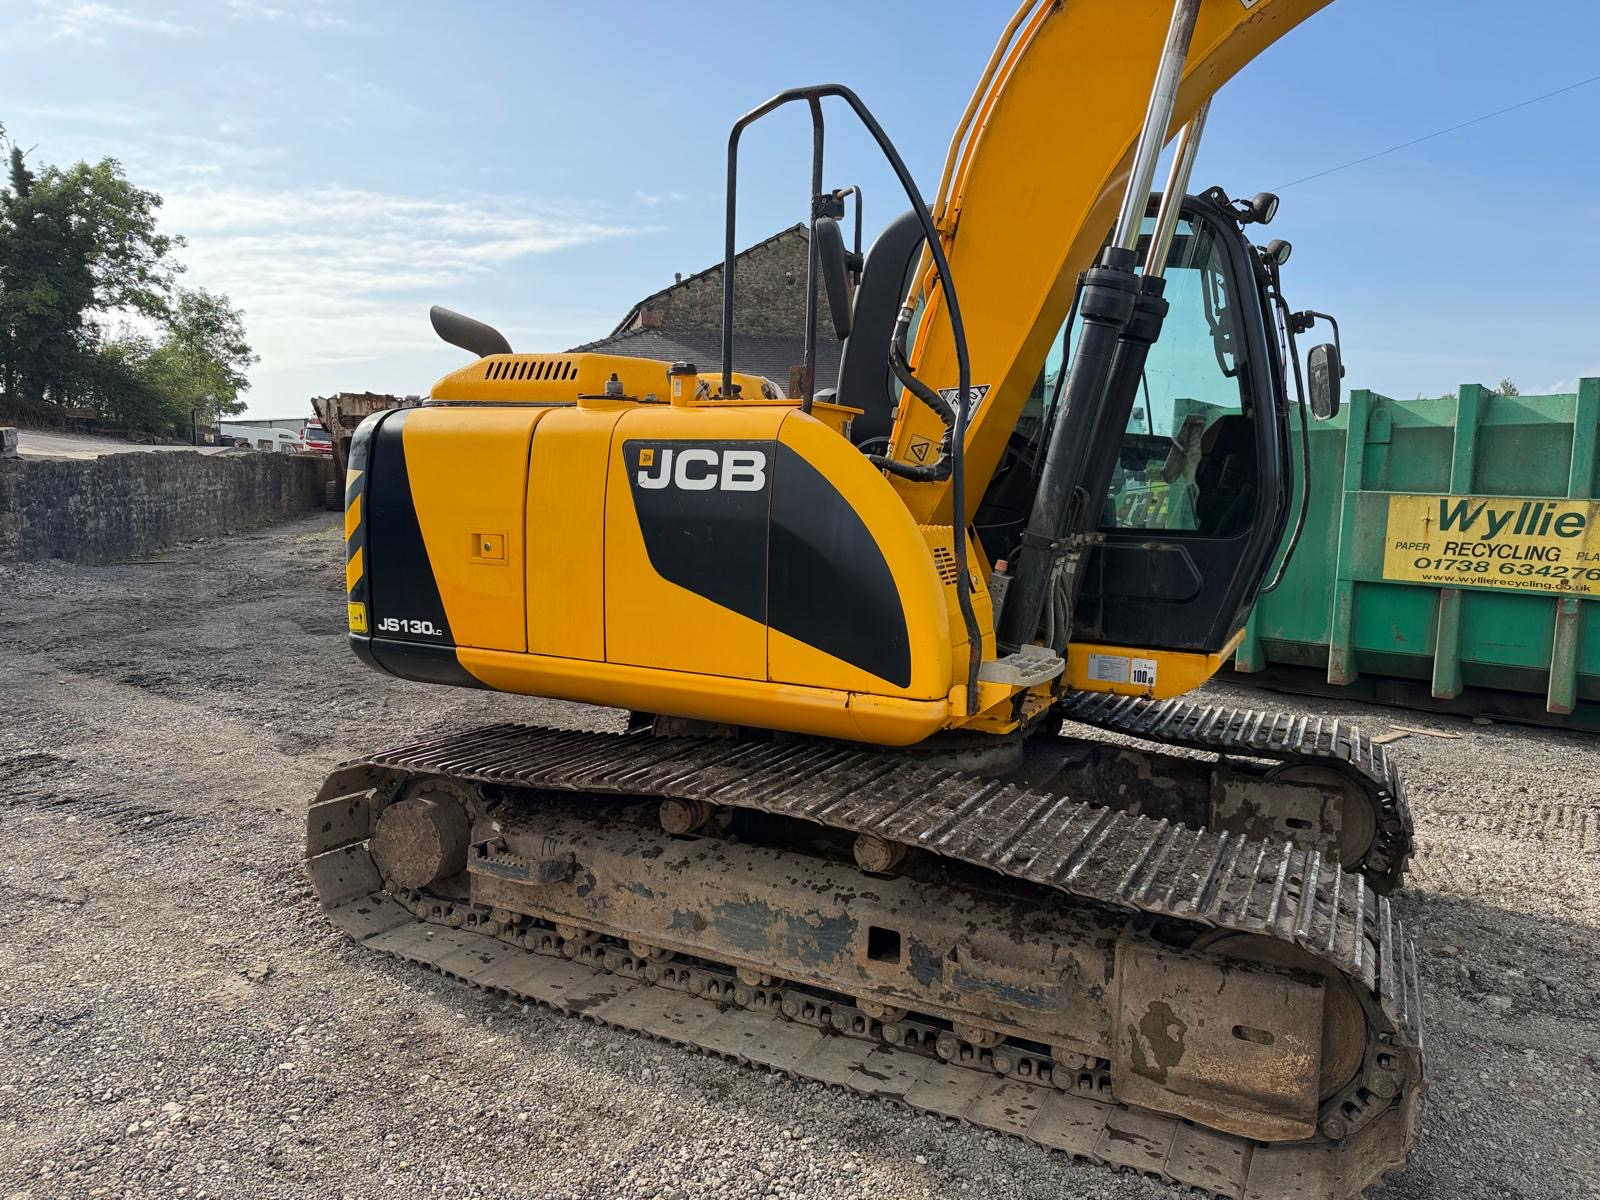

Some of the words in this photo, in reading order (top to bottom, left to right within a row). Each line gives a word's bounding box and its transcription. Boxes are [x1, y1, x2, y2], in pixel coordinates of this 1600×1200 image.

[637, 449, 766, 491] JCB
[1438, 499, 1586, 540] Wyllie
[1395, 542, 1431, 551] PAPER
[1443, 541, 1561, 562] RECYCLING
[1414, 557, 1489, 573] 01738
[1498, 563, 1600, 581] 634276
[1422, 574, 1592, 592] www.wyllierecycling.co.uk
[1133, 670, 1147, 683] 100
